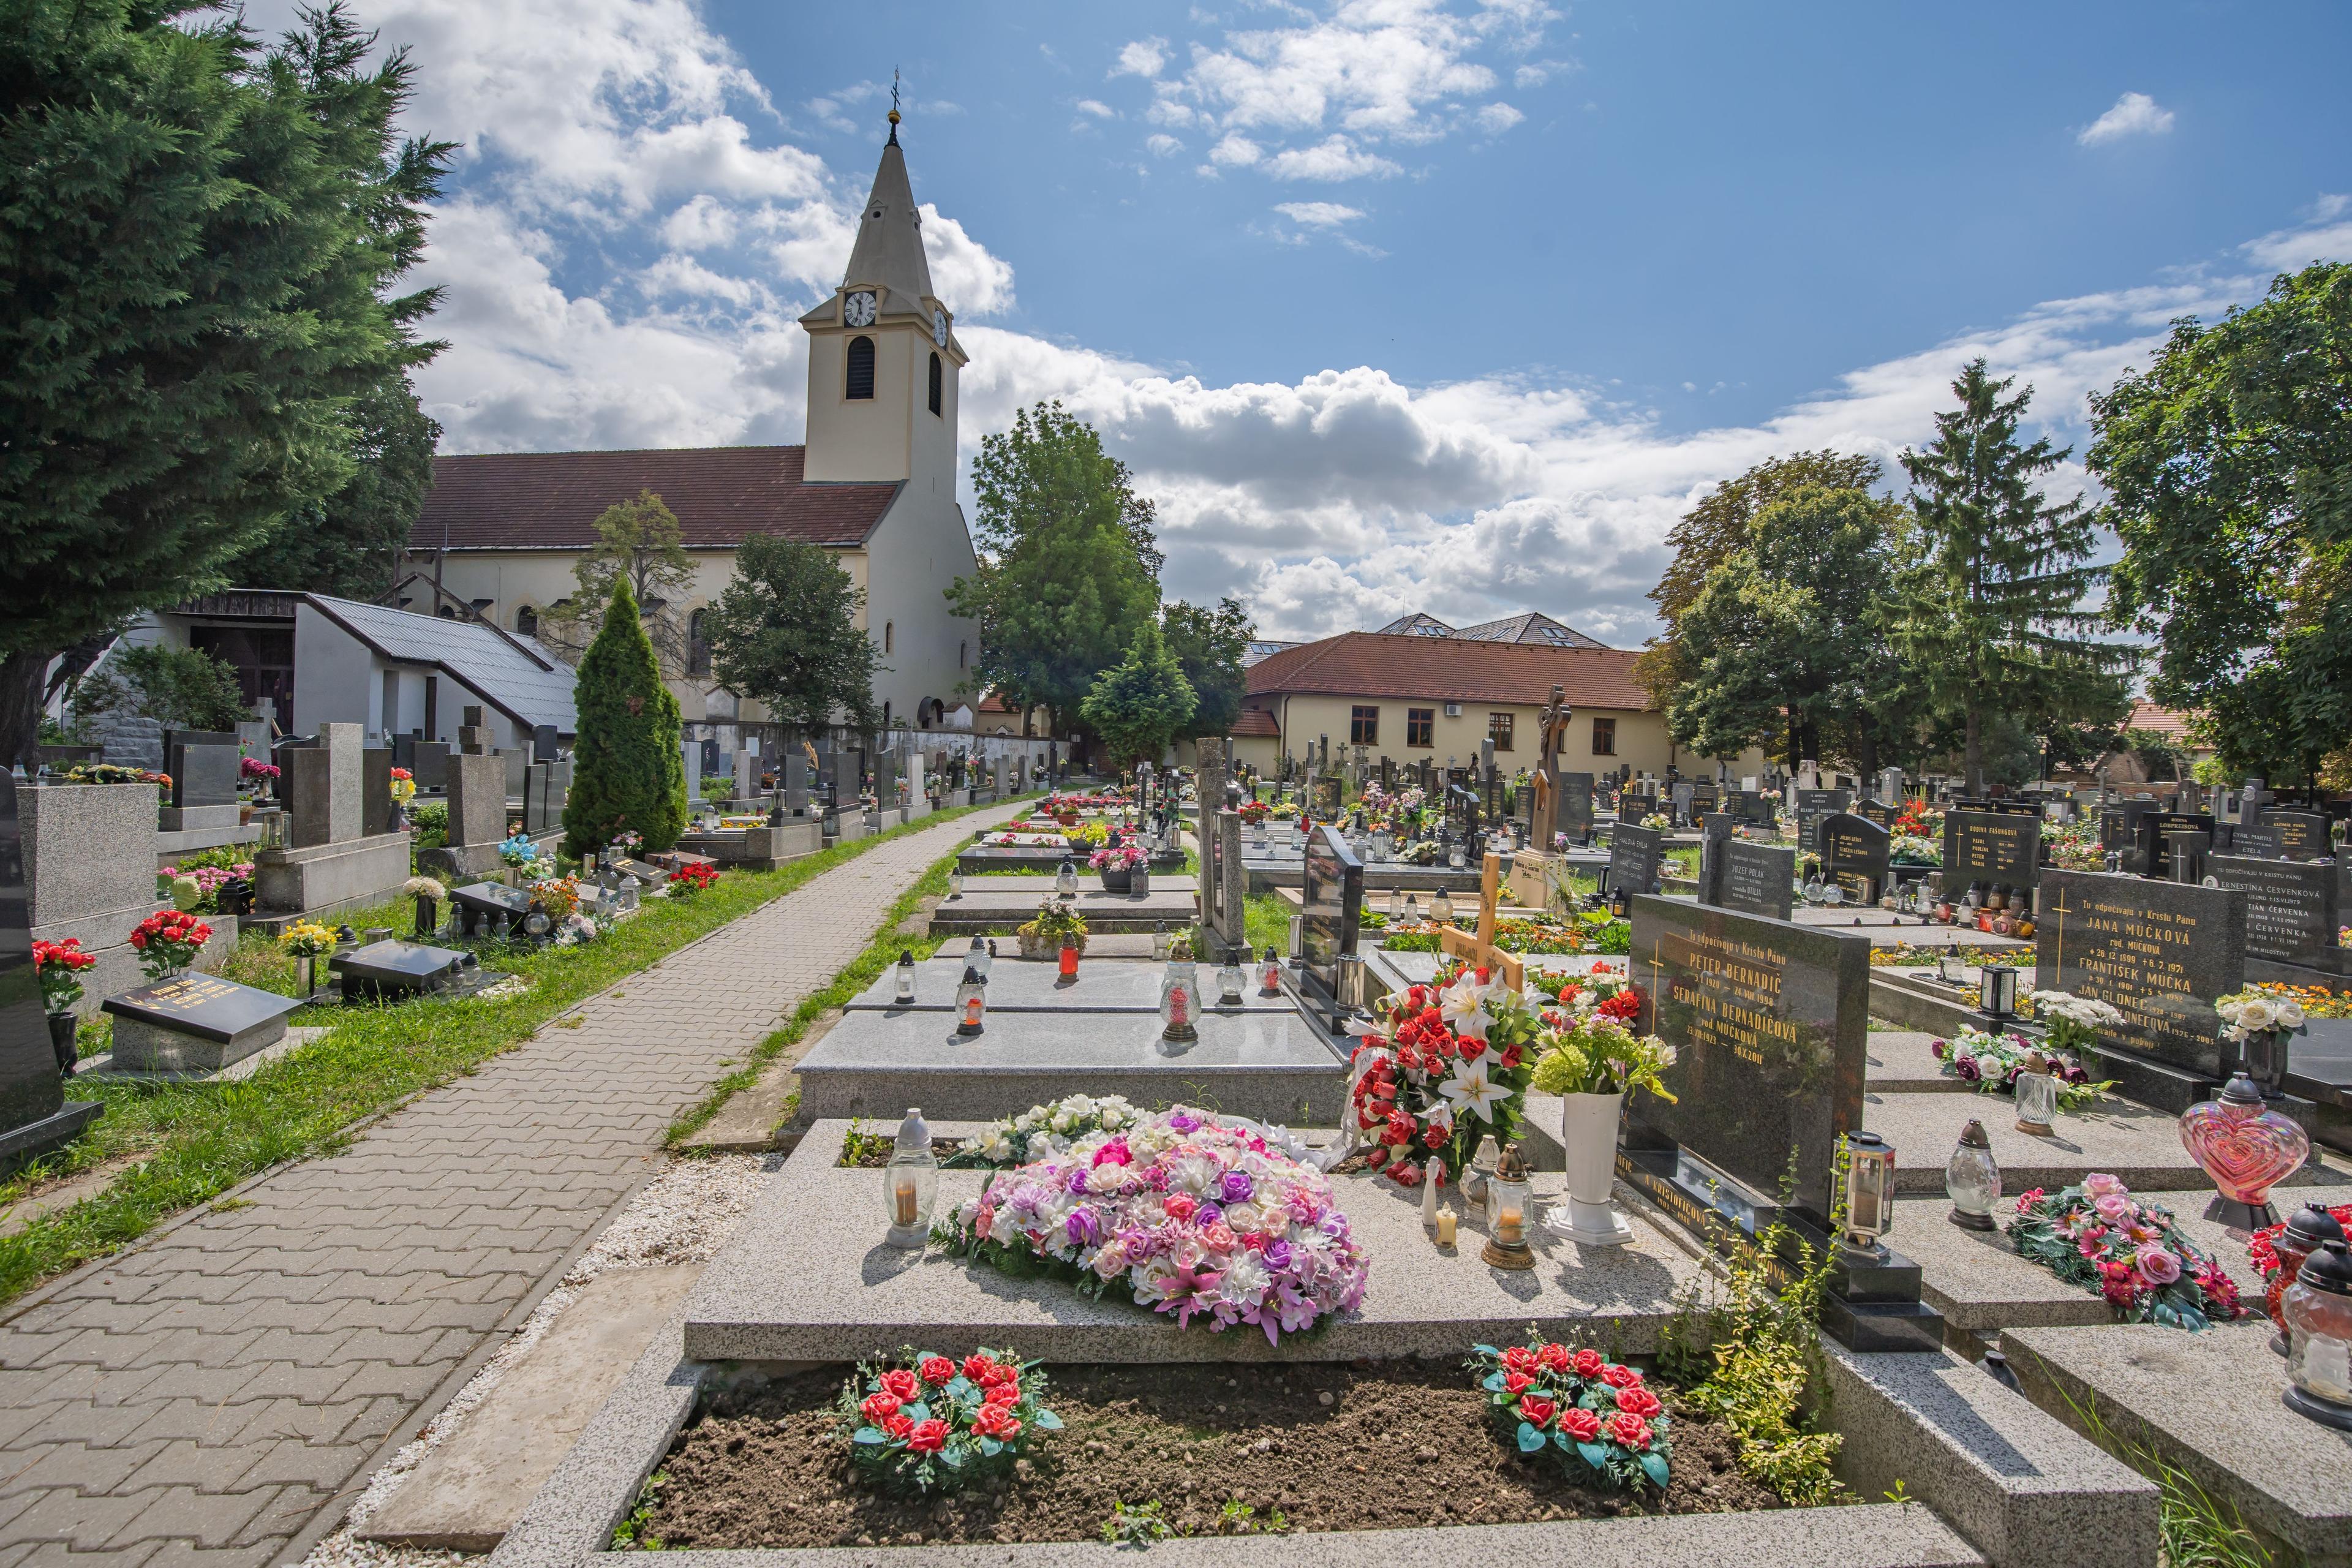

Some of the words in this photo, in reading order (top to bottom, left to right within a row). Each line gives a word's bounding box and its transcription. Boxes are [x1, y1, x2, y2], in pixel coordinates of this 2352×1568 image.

[2222, 881, 2263, 892] ERNESTÍNA
[2267, 884, 2320, 899] ČERVENKOVÁ
[2083, 900, 2091, 910] Tu
[2147, 910, 2171, 922] Kristu
[2176, 914, 2196, 926] Pánu
[2269, 905, 2309, 917] ČERVENKA
[2086, 917, 2119, 933] JANA
[2125, 922, 2190, 945] MÚČKOVÁ
[2255, 923, 2307, 937] ČERVENKA
[1689, 929, 1696, 941] Tu
[1742, 941, 1765, 960] Kristu
[1767, 948, 1786, 966] Pánu
[2120, 954, 2136, 964] 1899
[1690, 952, 1721, 975] PETER
[1727, 963, 1782, 994] BERNADIČ
[2079, 957, 2139, 981] FRANTIŠEK
[2147, 971, 2191, 993] MÚČKA
[1757, 993, 1774, 1007] 1998
[2078, 982, 2098, 998] JÁN
[2102, 989, 2148, 1011] GLONEC
[1674, 986, 1716, 1014] SERAFINA
[1722, 1002, 1797, 1044] BERNADIČOVÁ
[1717, 1020, 1757, 1048] MÚČKOVÁ
